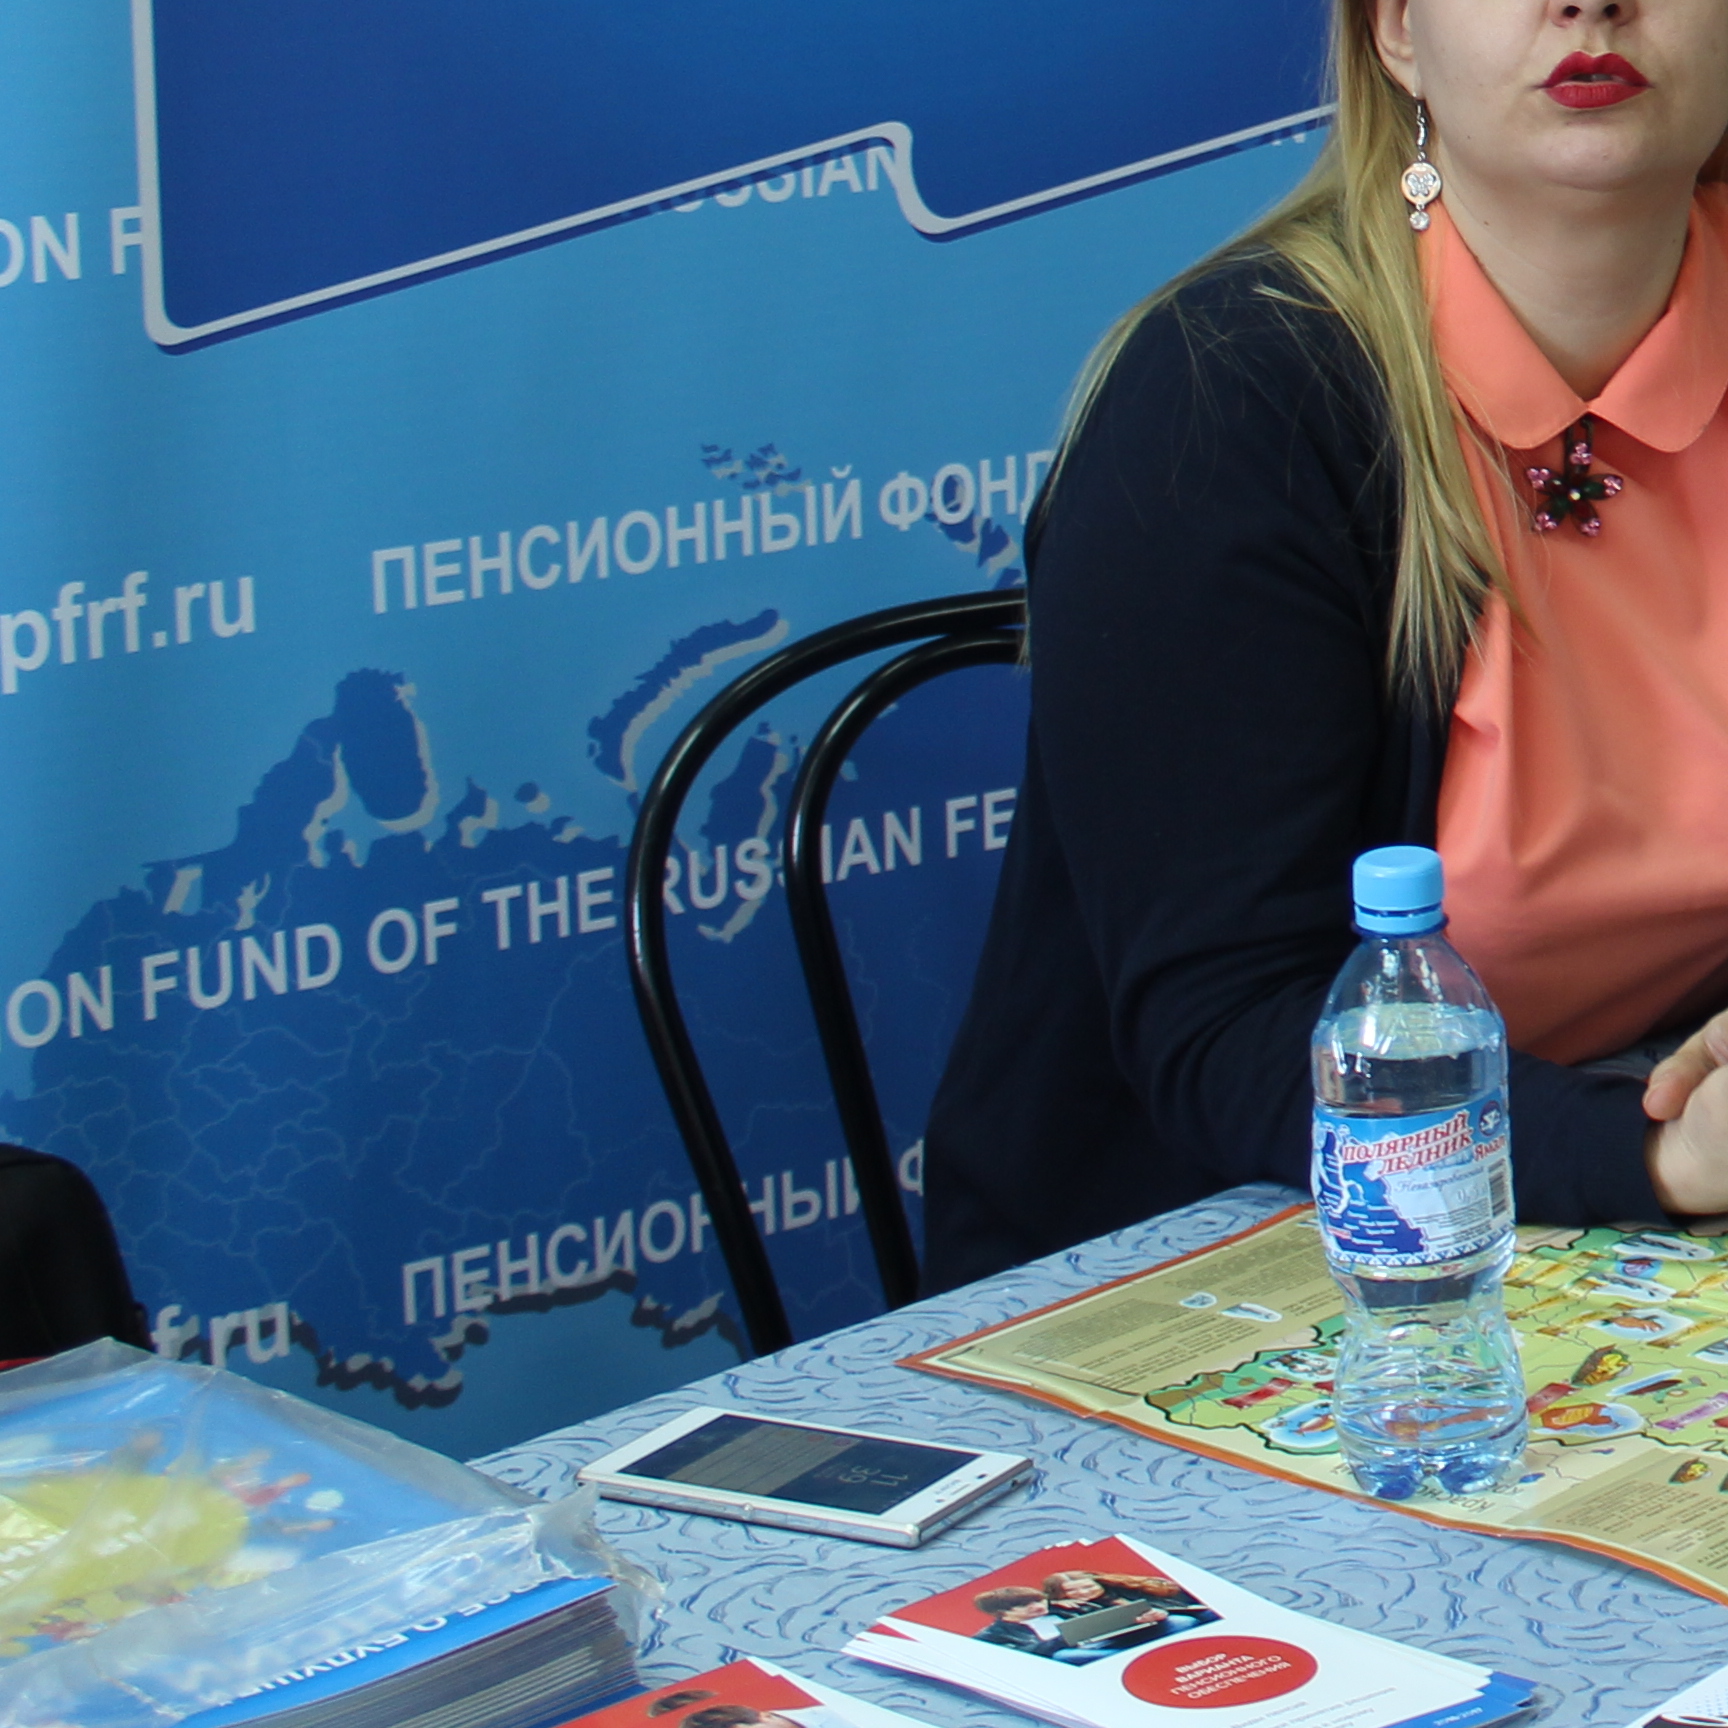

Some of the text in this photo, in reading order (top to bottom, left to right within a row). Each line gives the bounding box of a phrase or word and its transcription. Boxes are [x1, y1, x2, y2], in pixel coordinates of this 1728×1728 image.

[371, 466, 863, 615] ПЕНСИОННЫЙ
[142, 922, 342, 1022] FUND
[366, 896, 460, 975] OF
[481, 866, 617, 951] THE
[1343, 1110, 1470, 1162] ПОЛЯРНЫЙ
[1378, 1132, 1473, 1174] ЛЕДНИК
